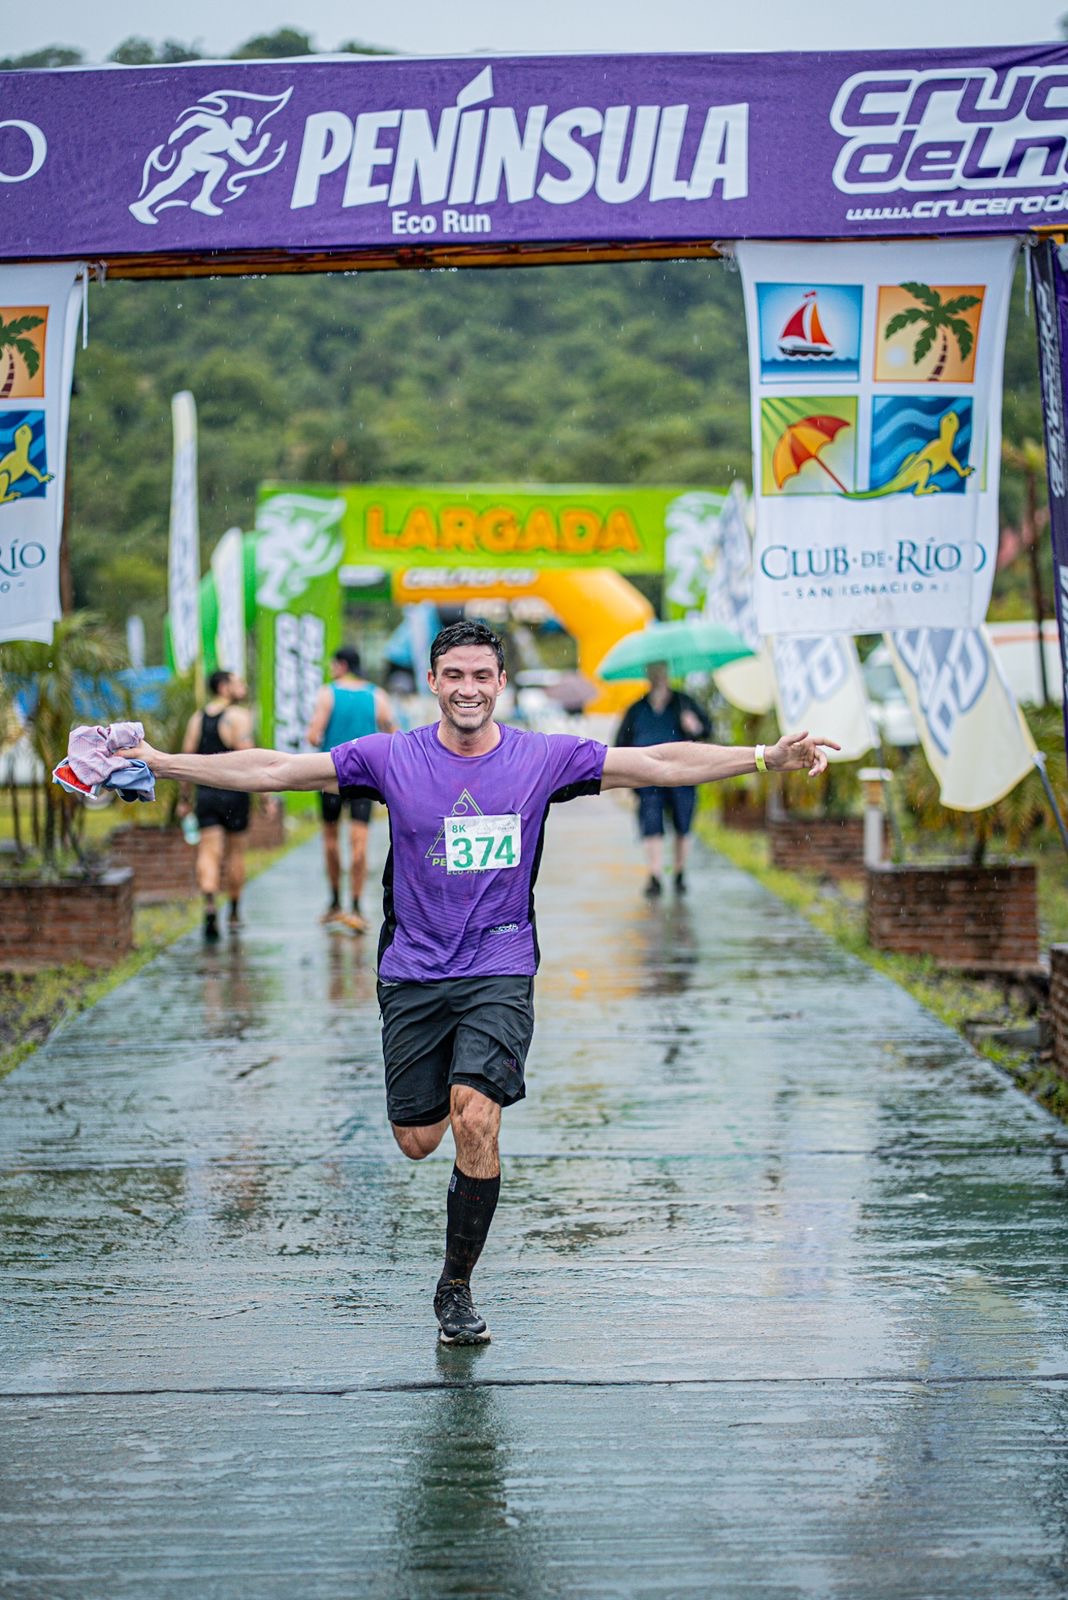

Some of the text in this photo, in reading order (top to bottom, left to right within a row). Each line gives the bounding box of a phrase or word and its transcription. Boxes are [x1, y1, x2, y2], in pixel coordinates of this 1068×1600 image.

[290, 65, 749, 210] PENÍNSULA
[392, 210, 491, 235] Eco Run
[367, 507, 641, 553] LARGADA
[451, 825, 466, 834] 8K
[452, 834, 516, 868] 374
